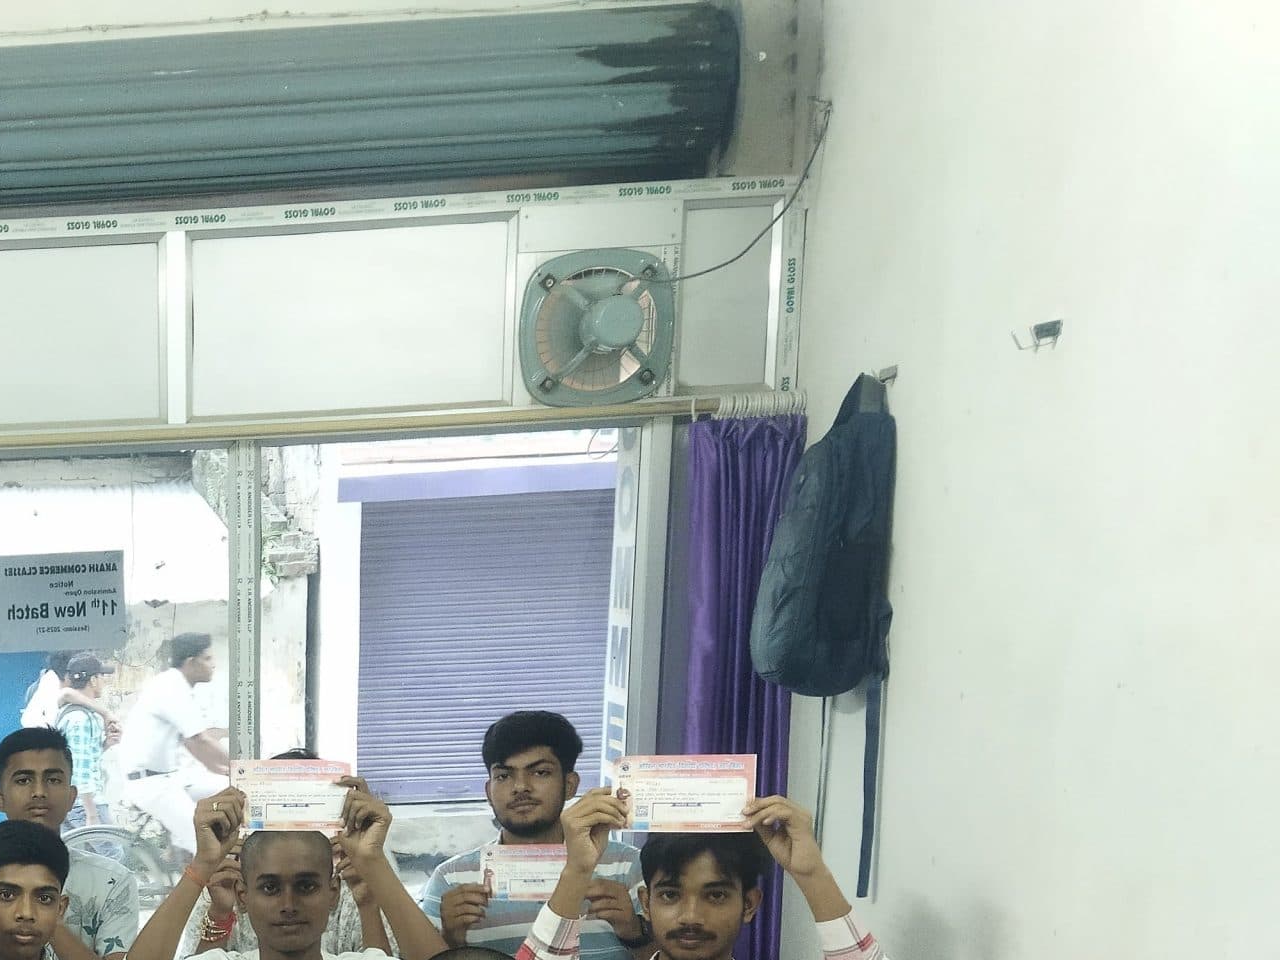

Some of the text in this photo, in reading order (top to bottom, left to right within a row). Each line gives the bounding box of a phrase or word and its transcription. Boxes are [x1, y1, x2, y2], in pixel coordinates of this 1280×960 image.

[731, 179, 785, 191] GOYAL GLOSS
[619, 186, 671, 196] GOYAL GLOSS
[506, 192, 559, 202] GOYAL GLOSS
[393, 199, 446, 211] GOYAL GLOSS
[284, 208, 336, 219] GOYAL GLOSS
[66, 220, 118, 230] GOYAL GLOSS
[175, 214, 226, 225] GOYAL GLOSS
[786, 257, 797, 314] GOYAL GLOSS
